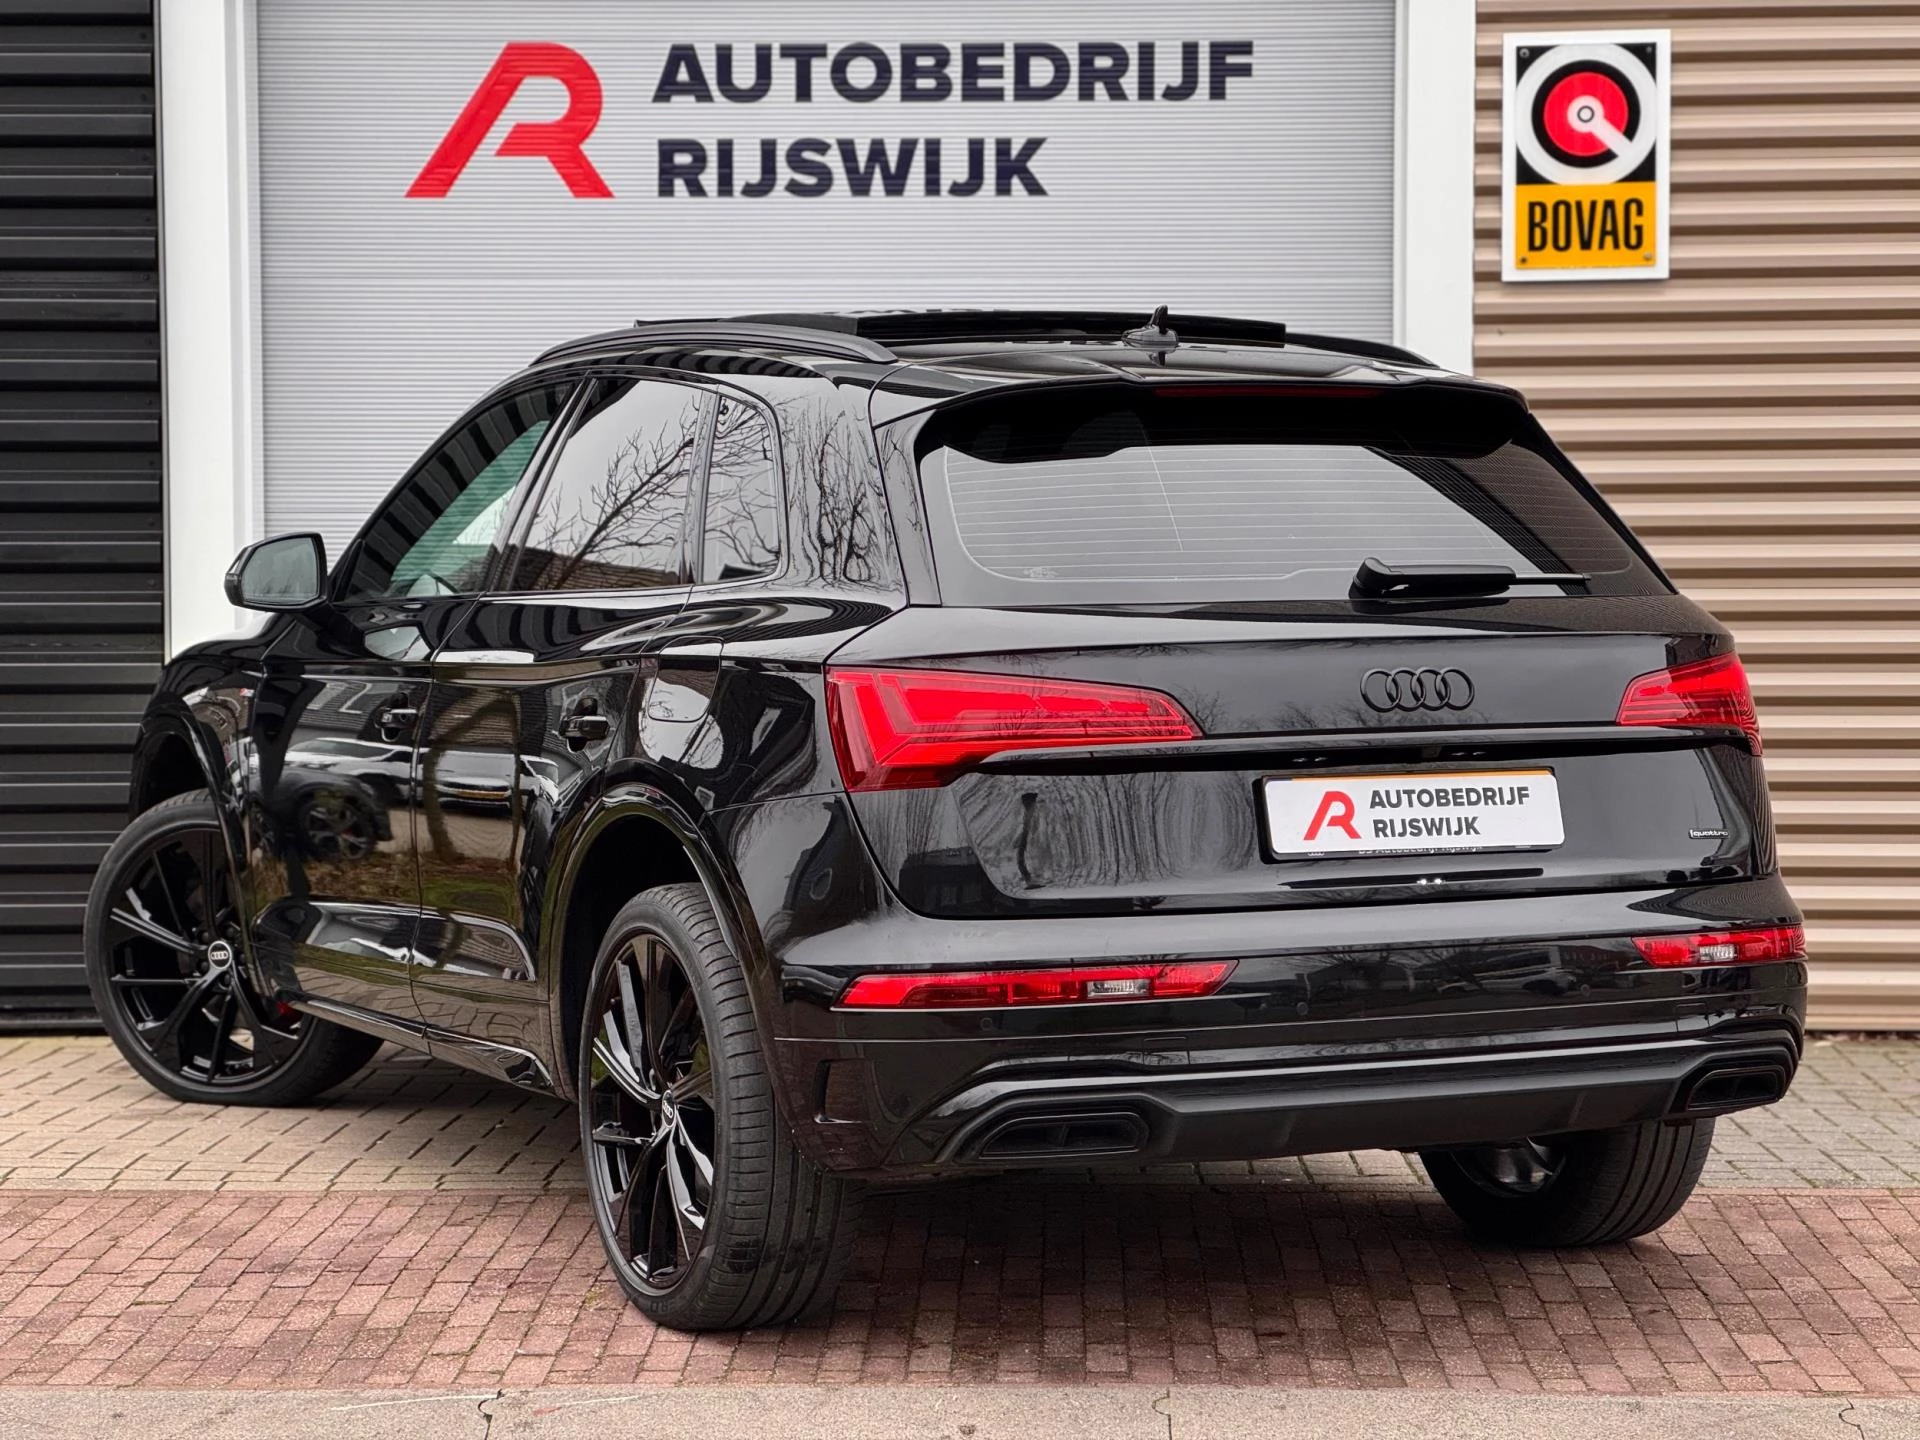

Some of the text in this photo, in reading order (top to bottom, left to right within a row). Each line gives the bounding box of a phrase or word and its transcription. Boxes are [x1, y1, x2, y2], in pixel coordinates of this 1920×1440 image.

[653, 41, 1254, 103] AUTOBEDRIJF
[658, 138, 1048, 197] RIJSWIJK
[1528, 198, 1643, 252] BOVAG
[1370, 786, 1530, 809] AUTOBEDRIJF
[1373, 816, 1480, 838] RIJSWIJK
[1692, 829, 1729, 838] quattro
